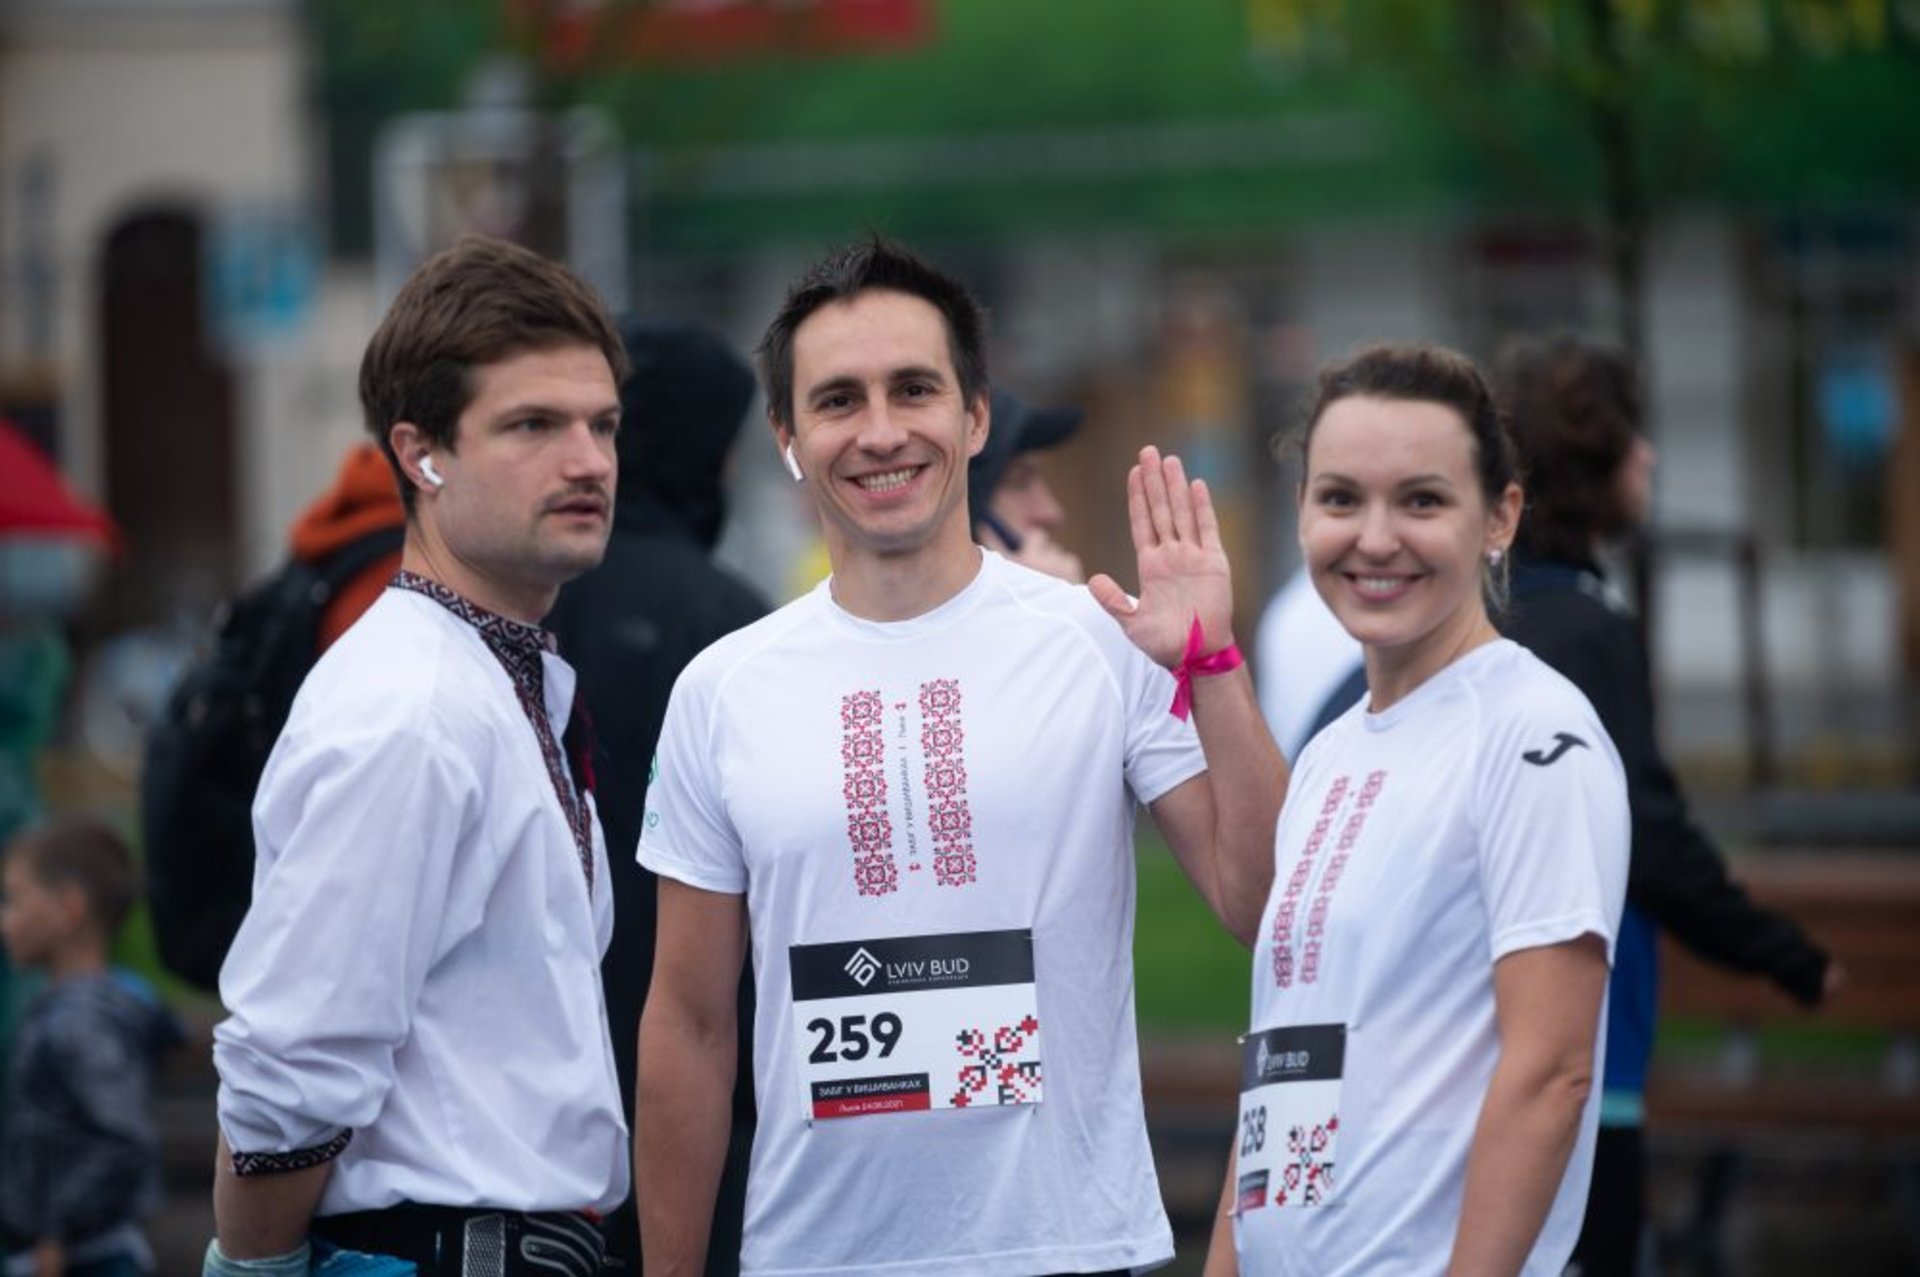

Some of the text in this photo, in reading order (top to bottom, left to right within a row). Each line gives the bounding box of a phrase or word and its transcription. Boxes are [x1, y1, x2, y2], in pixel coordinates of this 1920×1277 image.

[887, 958, 969, 978] LVIV BUD
[806, 1012, 903, 1064] 259
